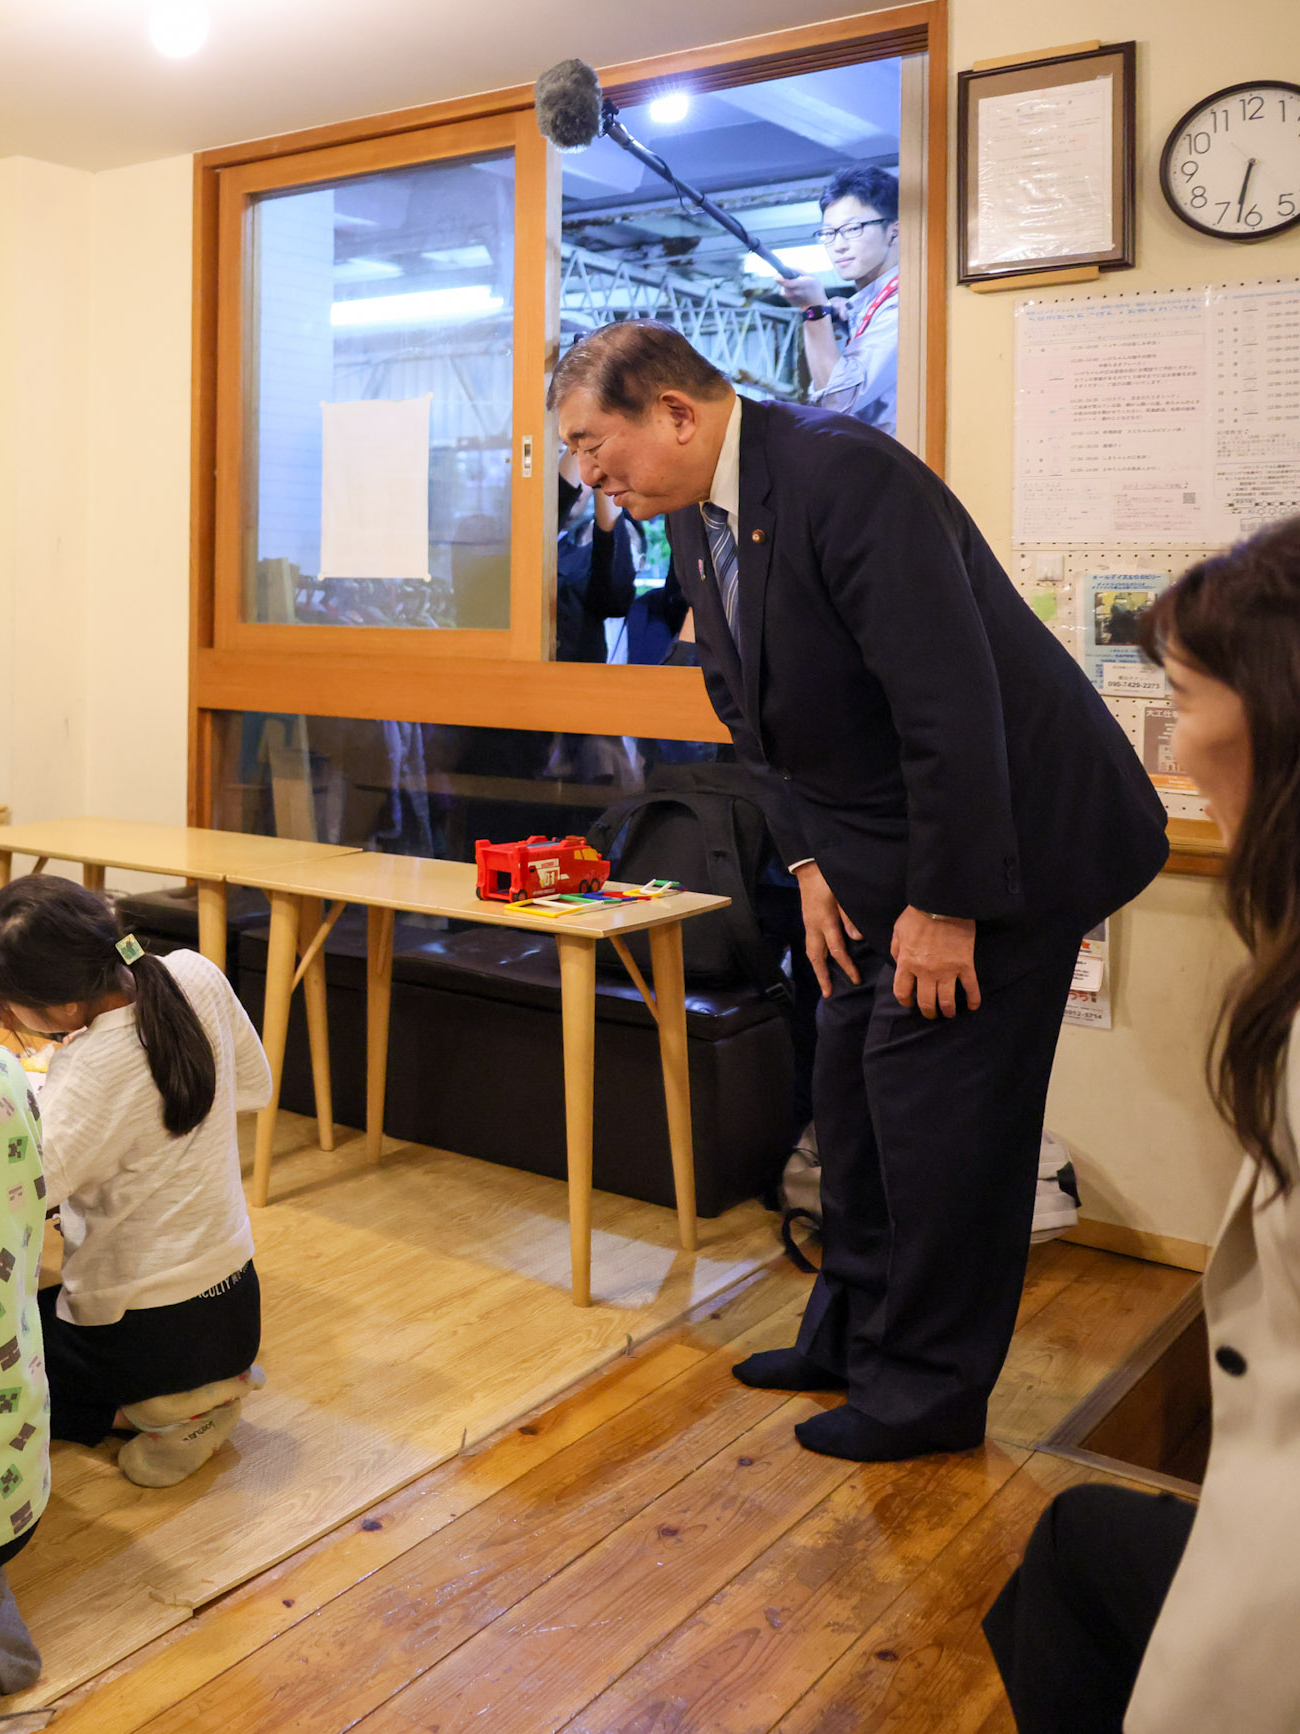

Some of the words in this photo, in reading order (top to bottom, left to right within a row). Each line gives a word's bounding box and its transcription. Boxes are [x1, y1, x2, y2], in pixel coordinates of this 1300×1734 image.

[1239, 96, 1264, 121] 12
[1278, 100, 1285, 122] 1
[1210, 109, 1228, 133] 11
[1186, 131, 1211, 155] 10
[1180, 160, 1199, 183] 9
[1190, 185, 1208, 209] 8
[1277, 193, 1295, 217] 5
[1215, 201, 1231, 225] 7
[1244, 203, 1263, 227] 6
